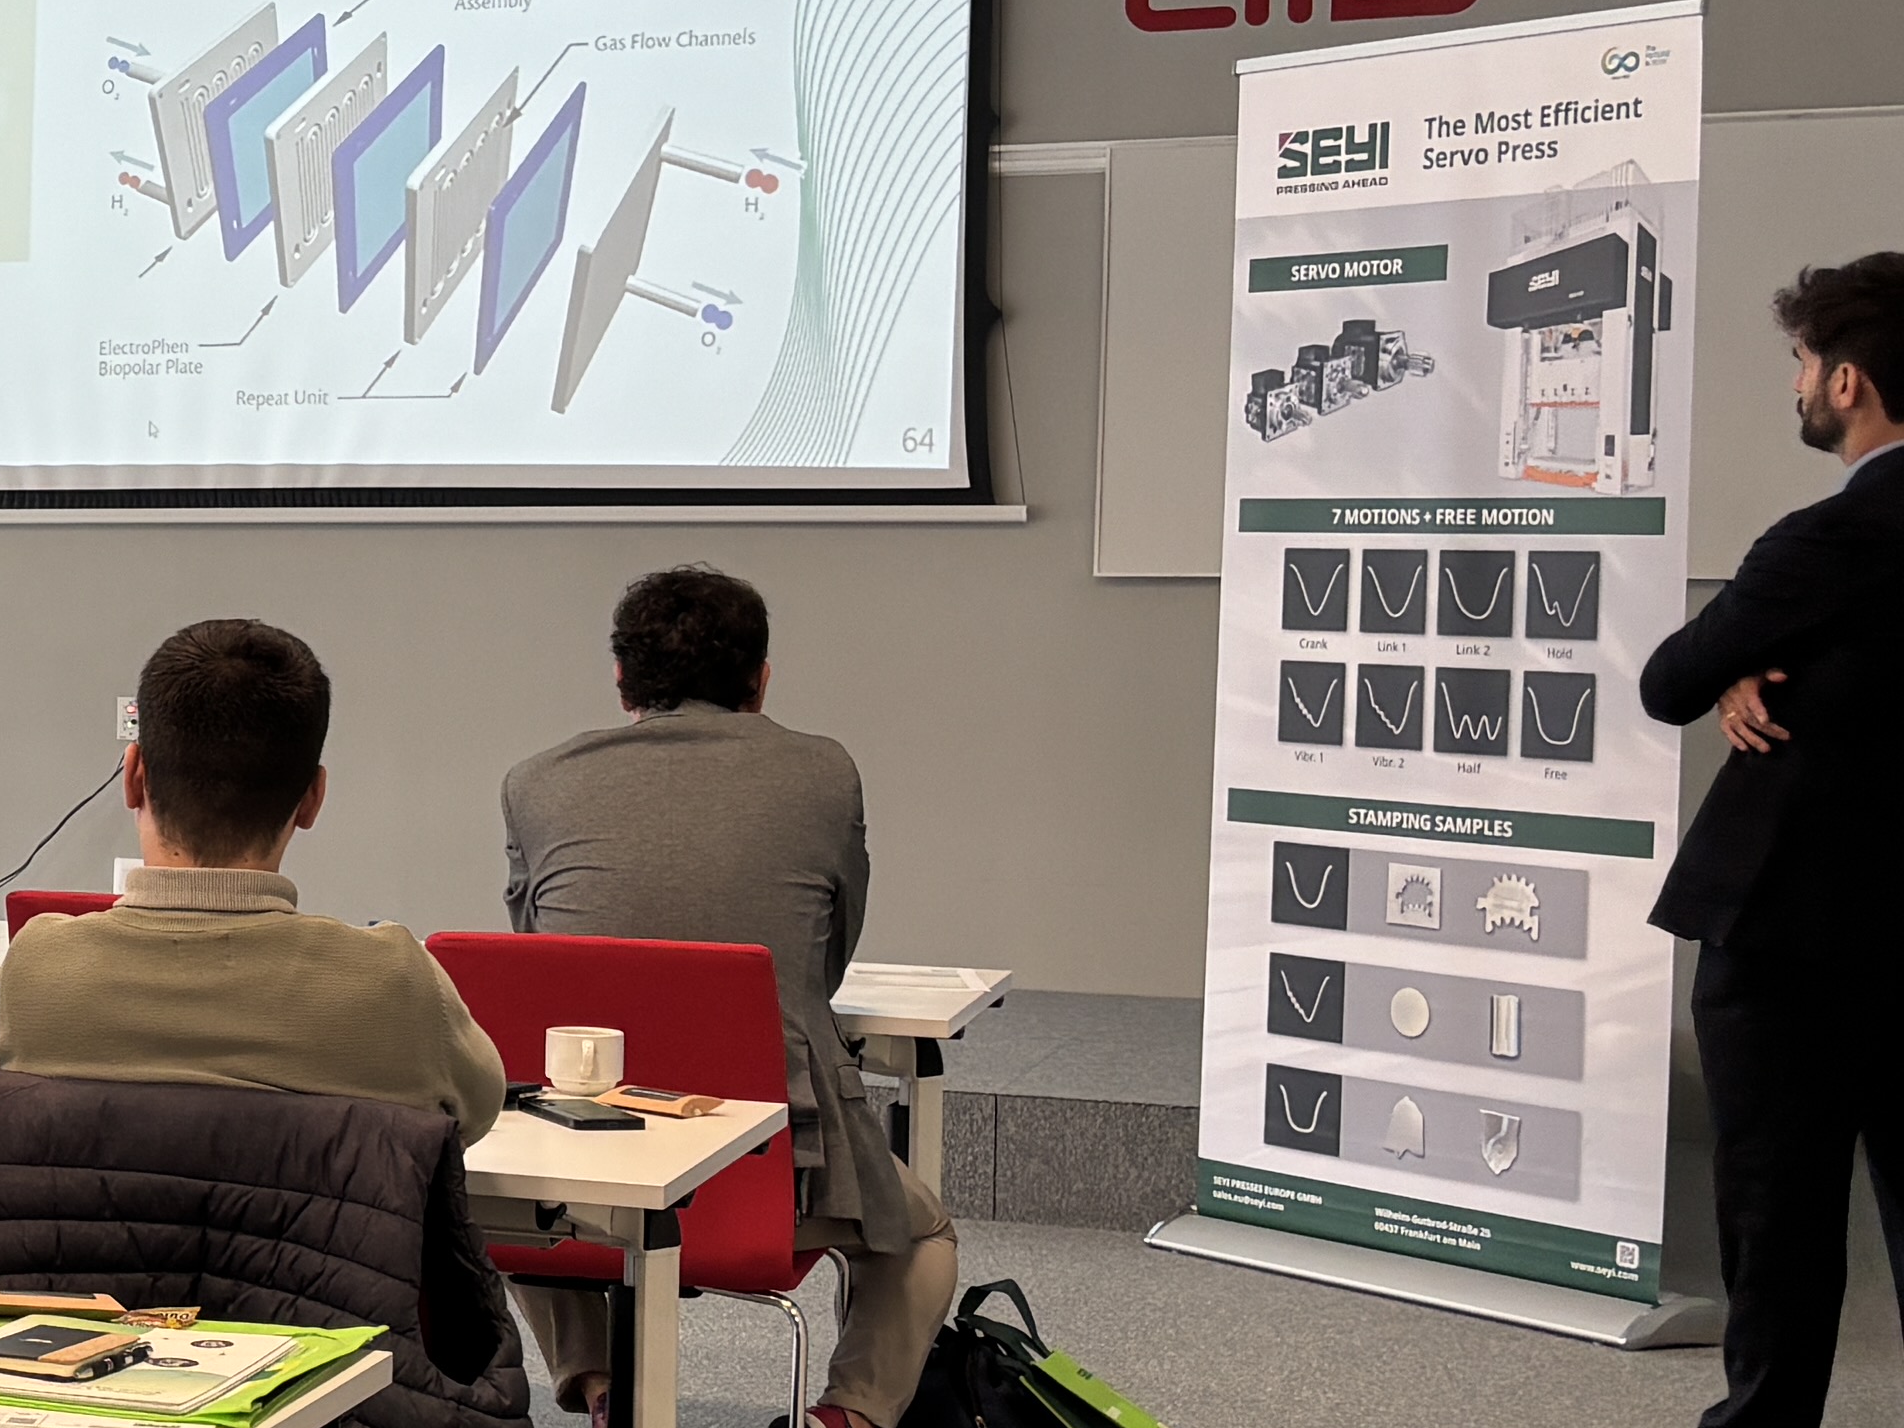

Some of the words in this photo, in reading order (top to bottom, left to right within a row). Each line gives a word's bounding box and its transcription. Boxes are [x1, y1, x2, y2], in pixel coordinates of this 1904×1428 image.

[594, 35, 626, 51] Gas
[631, 32, 671, 49] Flow
[675, 27, 756, 48] Channels
[1424, 115, 1466, 140] The
[1474, 107, 1532, 135] Most
[1540, 96, 1643, 128] Efficient
[1277, 121, 1390, 180] SEYI
[1423, 144, 1489, 170] Servo
[1497, 139, 1558, 166] Press
[1276, 181, 1339, 196] PRESSING
[1342, 176, 1389, 191] AHEAD
[1291, 262, 1341, 281] SERVO
[1344, 258, 1403, 278] MOTOR
[99, 339, 189, 356] ElectroPhen
[99, 359, 161, 380] Biopolar
[165, 358, 203, 375] Plate
[236, 390, 290, 411] Repeat
[294, 390, 329, 405] Unit
[901, 427, 935, 454] 64
[1332, 509, 1342, 524] 7
[1344, 508, 1420, 525] MOTIONS
[1436, 508, 1476, 525] FREE
[1481, 508, 1555, 525] MOTION
[1299, 638, 1328, 650] Crank
[1378, 641, 1398, 652] Link
[1401, 642, 1406, 651] 1
[1456, 644, 1480, 656] Link
[1483, 645, 1491, 656] 2
[1547, 647, 1573, 659] Hold
[1294, 750, 1316, 761] Vibr.
[1373, 756, 1395, 767] Vibr.
[1398, 758, 1404, 768] 2
[1457, 762, 1481, 774] Half
[1544, 768, 1568, 780] Free
[1348, 807, 1431, 832] STAMPING
[1434, 815, 1513, 838] SAMPLES
